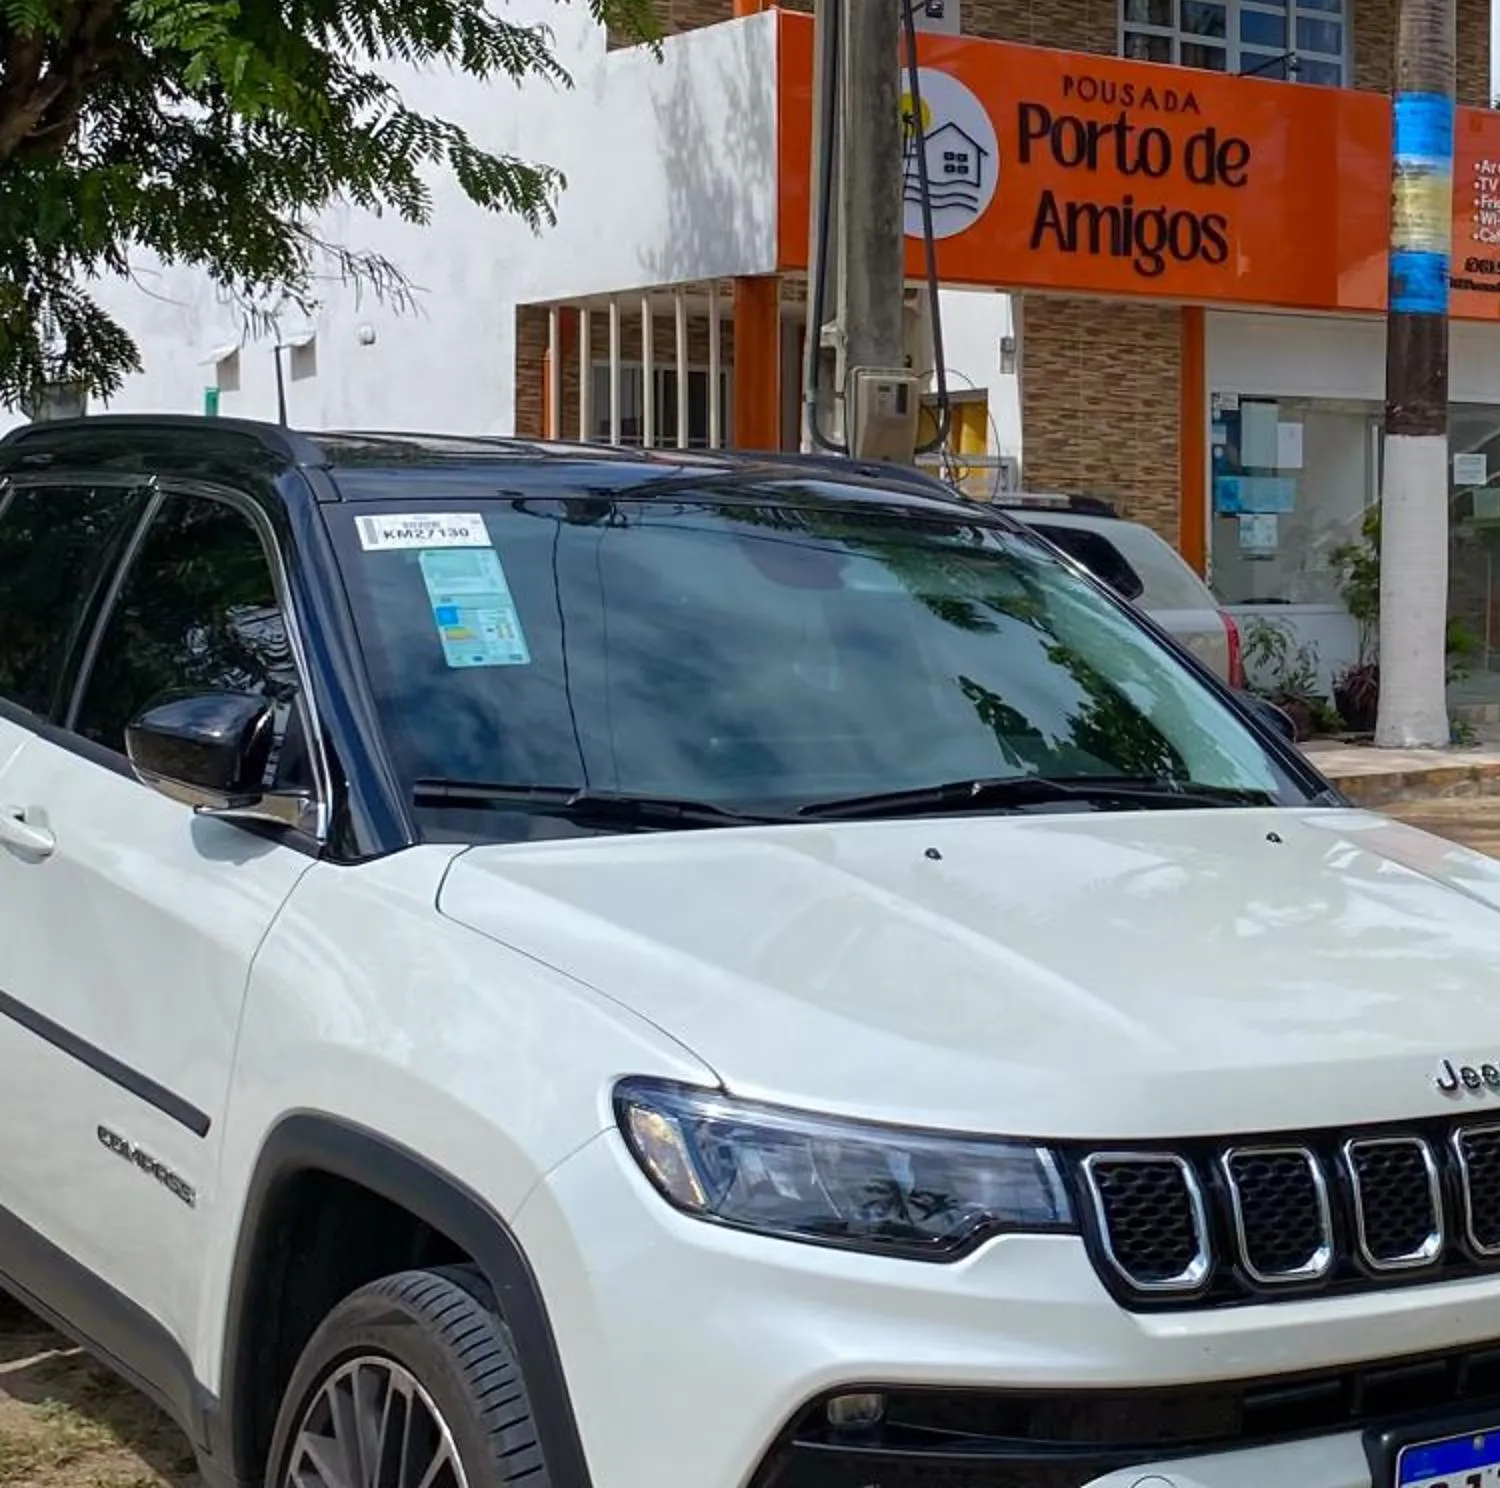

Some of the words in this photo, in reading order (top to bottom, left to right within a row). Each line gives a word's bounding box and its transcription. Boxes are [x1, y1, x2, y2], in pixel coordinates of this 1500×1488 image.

[1062, 74, 1201, 115] POUSADA
[1017, 101, 1173, 179] Porto
[1184, 127, 1251, 188] de
[1480, 176, 1499, 191] TV
[1029, 189, 1229, 278] Amigos
